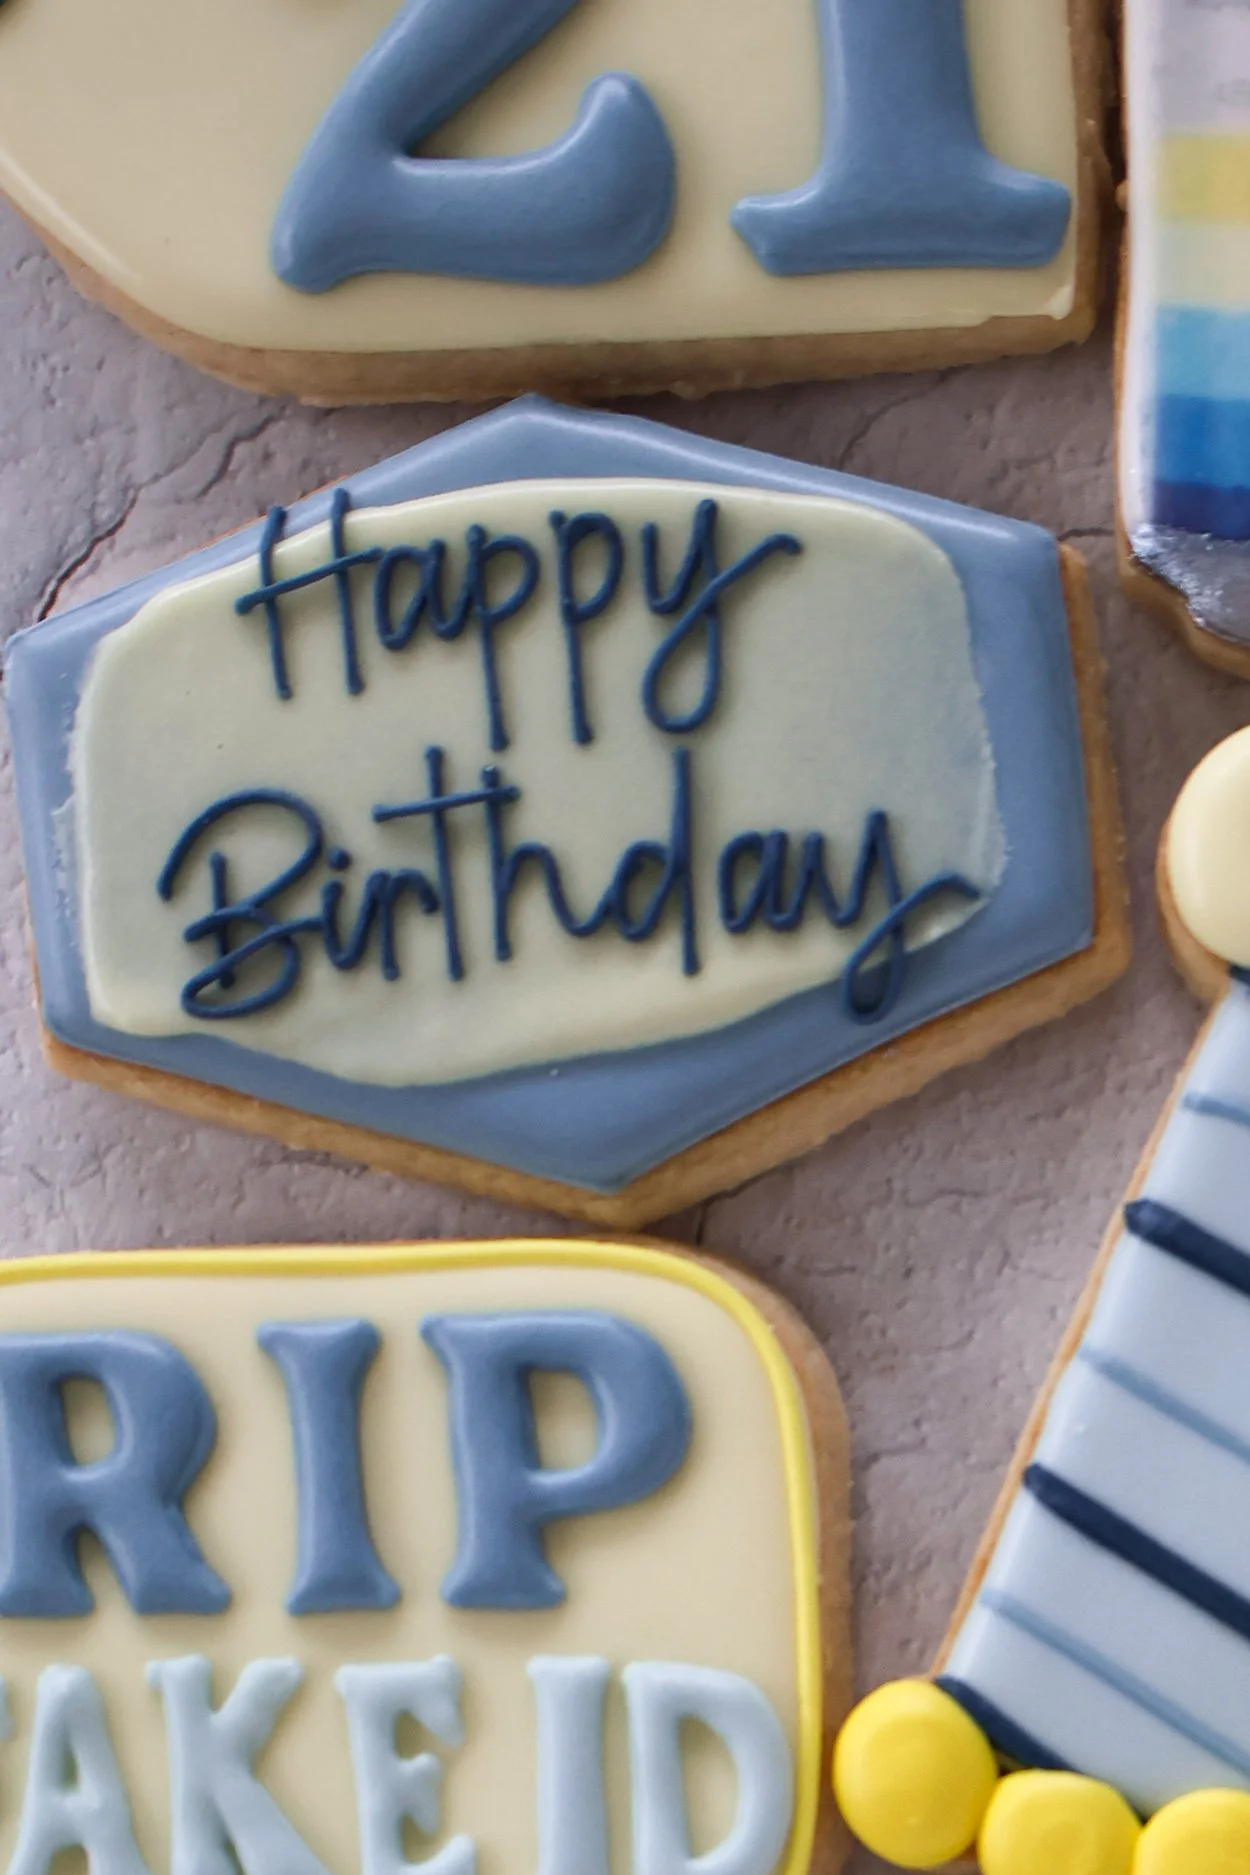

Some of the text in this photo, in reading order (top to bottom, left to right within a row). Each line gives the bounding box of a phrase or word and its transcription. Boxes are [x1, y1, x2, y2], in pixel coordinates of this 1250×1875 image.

[235, 488, 803, 735] Happy
[156, 746, 982, 1023] Birthday
[0, 1309, 693, 1617] RIP
